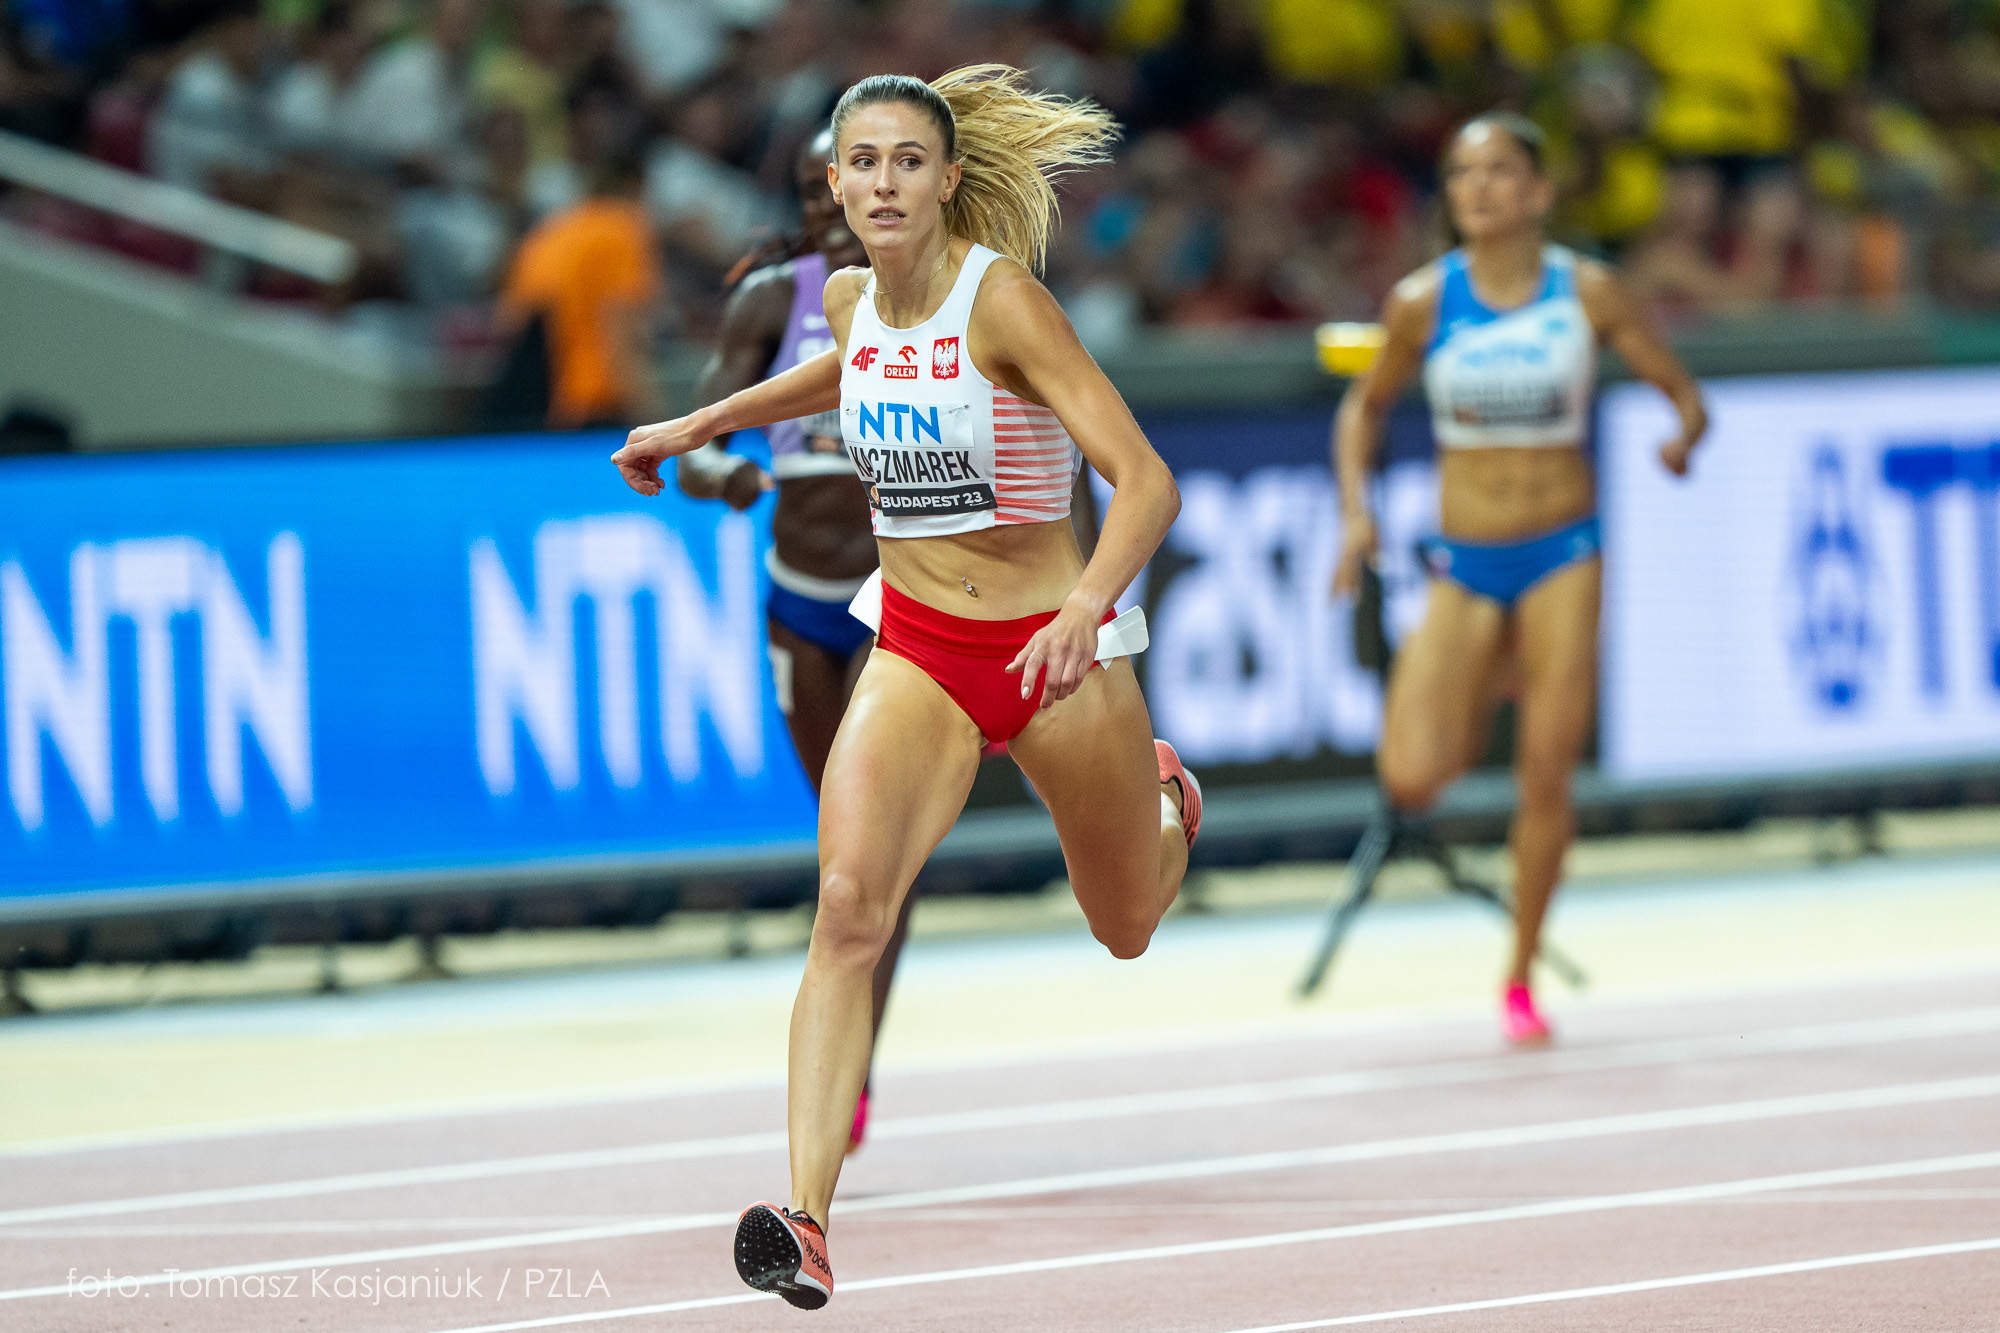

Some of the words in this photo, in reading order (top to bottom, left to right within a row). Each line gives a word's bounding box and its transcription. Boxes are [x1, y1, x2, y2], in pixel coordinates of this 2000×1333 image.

[852, 346, 879, 371] 4F
[885, 366, 916, 378] ORLEN
[860, 401, 942, 445] NTN
[881, 494, 960, 508] BUDAPEST
[962, 491, 984, 506] 23
[467, 510, 766, 800] NTN
[2, 530, 314, 832] NTN
